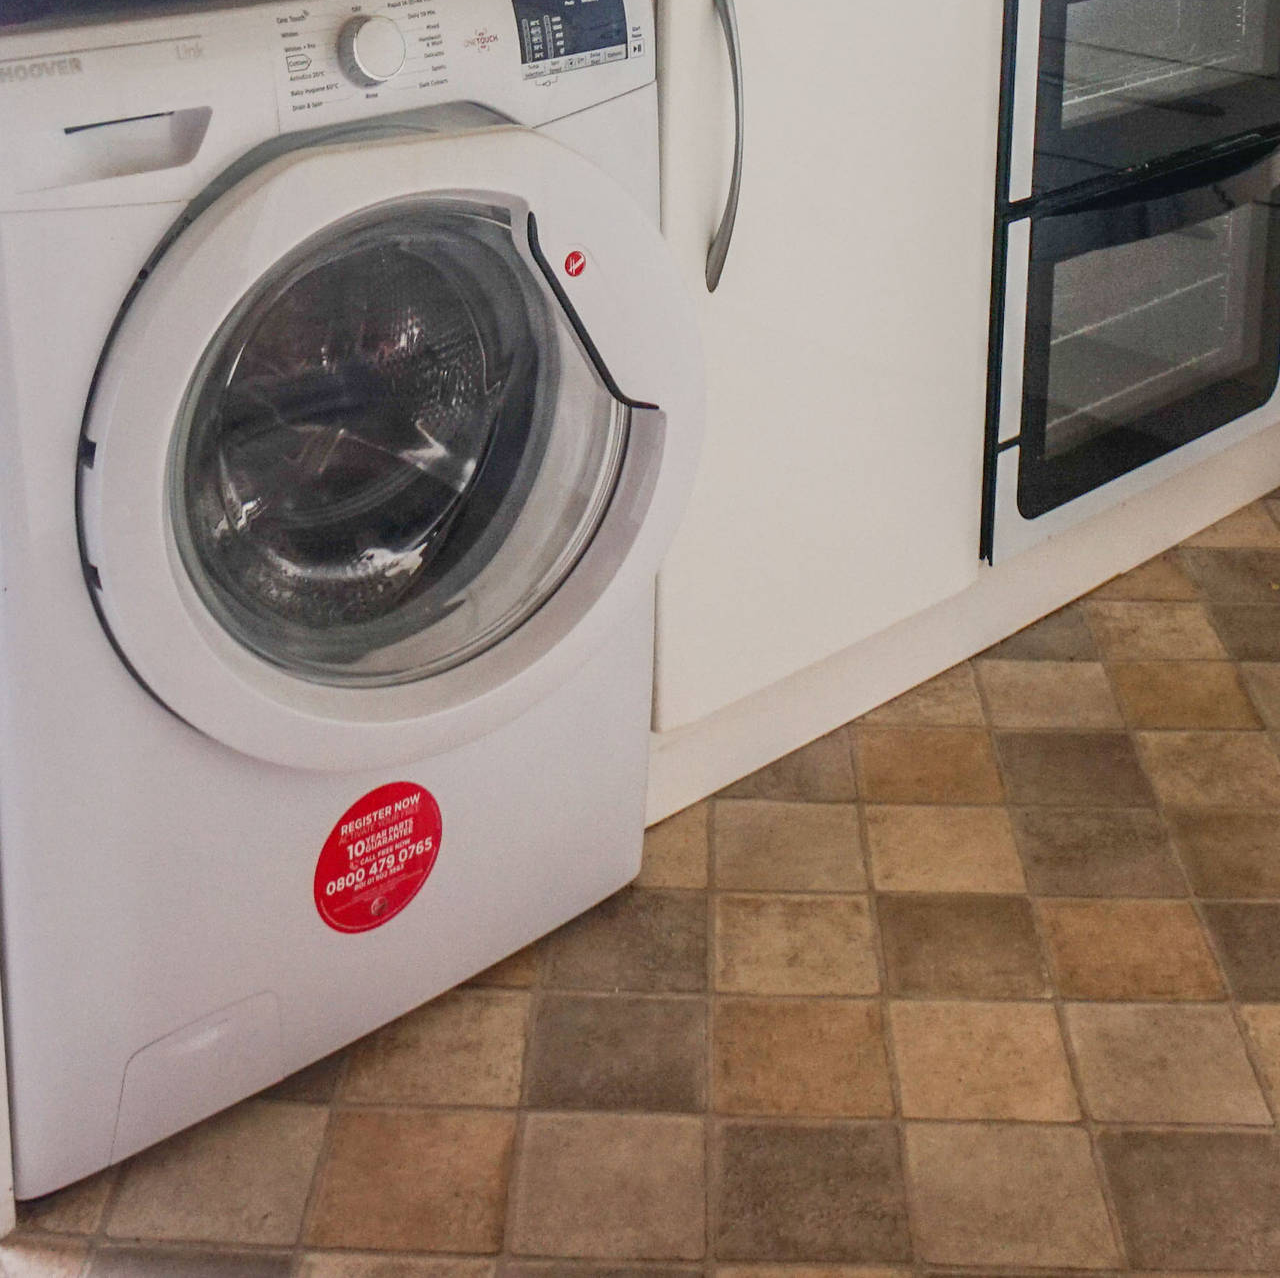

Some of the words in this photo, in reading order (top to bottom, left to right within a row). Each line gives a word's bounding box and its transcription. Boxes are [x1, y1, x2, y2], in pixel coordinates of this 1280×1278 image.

[289, 13, 307, 23] Touch
[174, 42, 204, 61] Link
[290, 88, 304, 98] Baby
[340, 805, 393, 837] REGISTER
[394, 792, 421, 811] NOW
[365, 829, 388, 845] YEAR
[388, 817, 414, 836] PARTS
[365, 827, 414, 854] GUARANTEE
[346, 839, 366, 861] 10
[359, 854, 377, 866] CALL
[377, 846, 395, 859] FREE
[394, 838, 412, 851] NOW
[325, 867, 366, 896] 0800
[369, 853, 396, 877] 479
[397, 836, 433, 864] 0765
